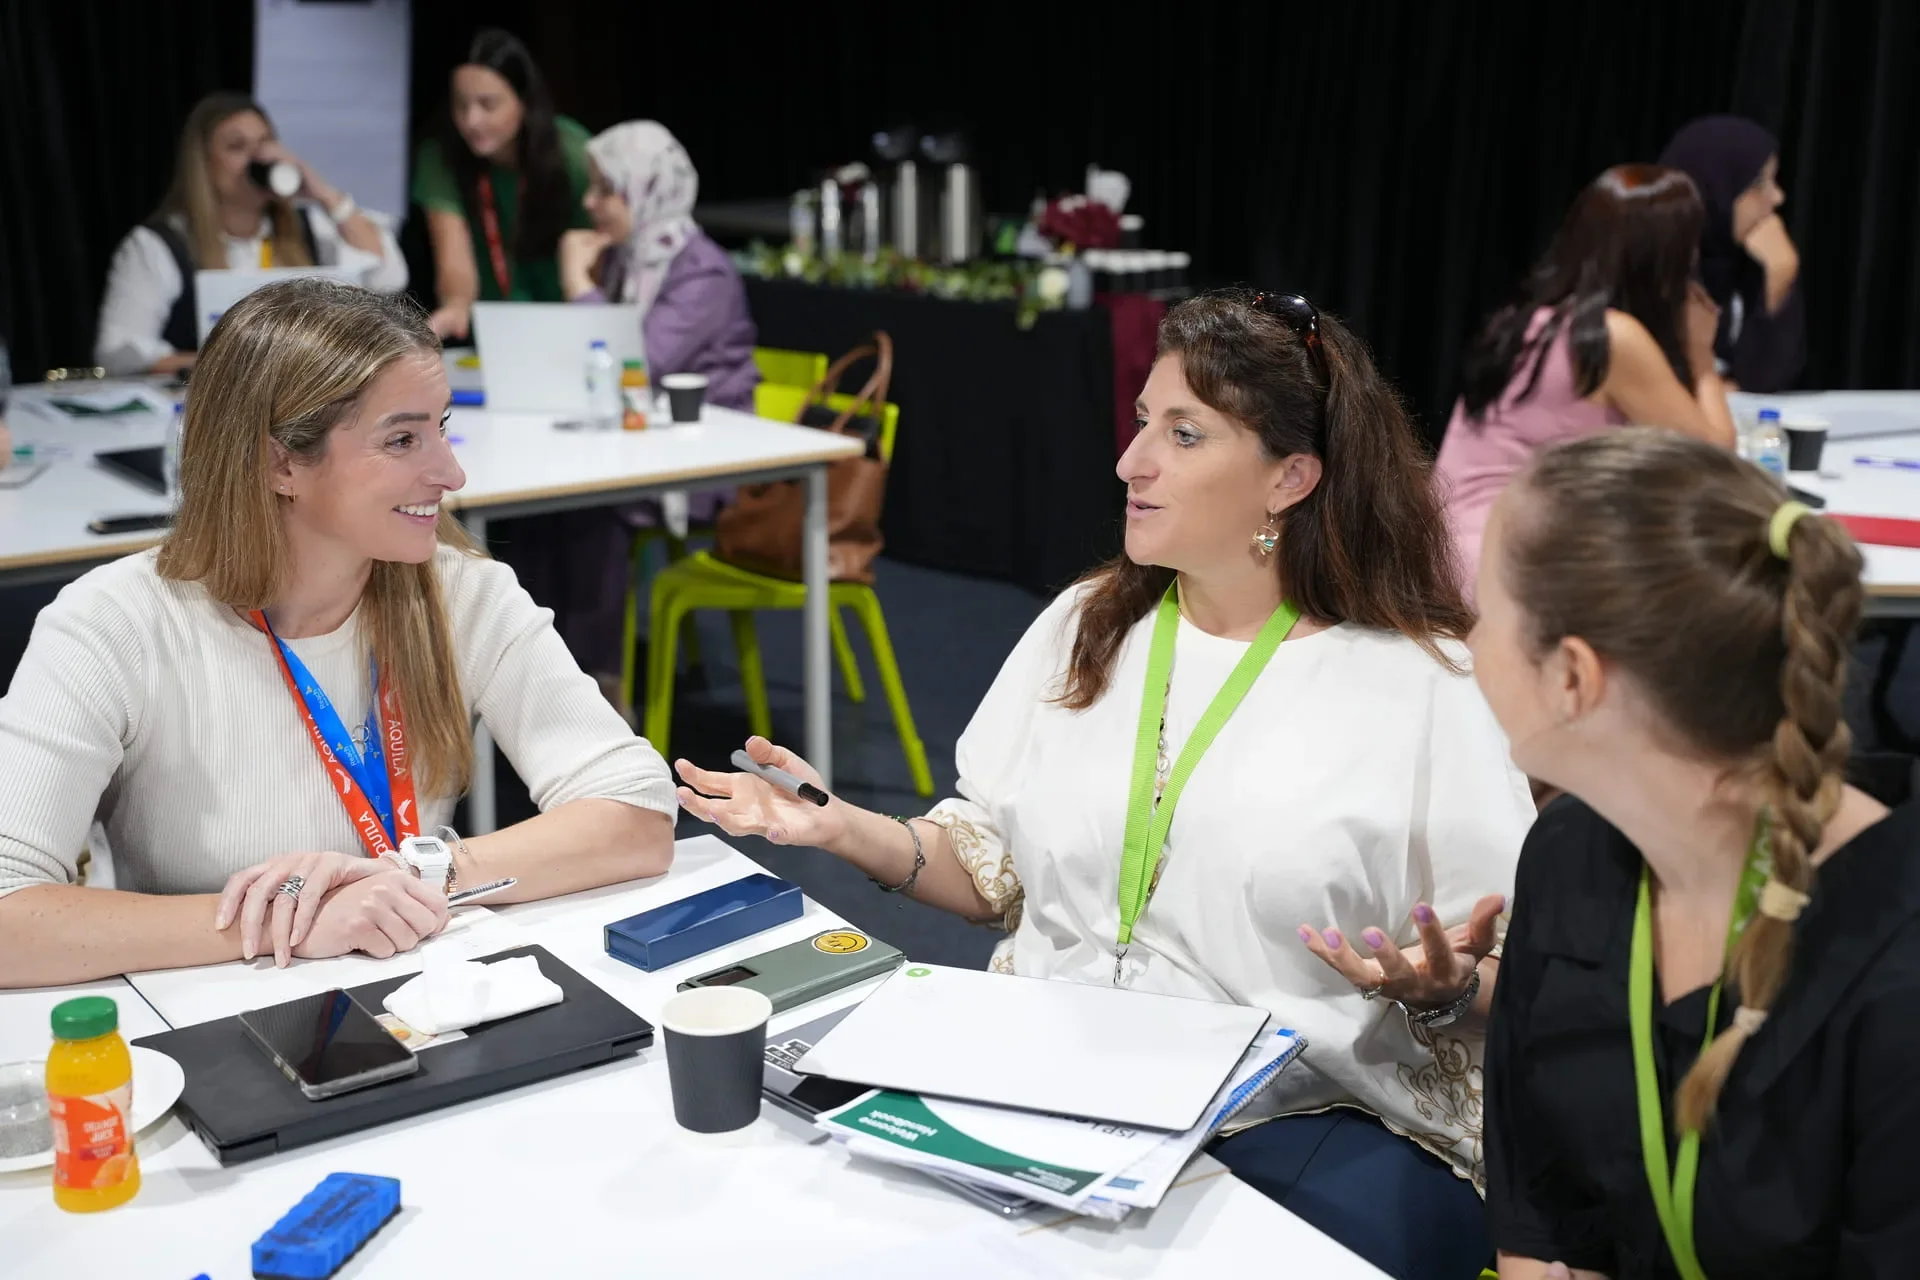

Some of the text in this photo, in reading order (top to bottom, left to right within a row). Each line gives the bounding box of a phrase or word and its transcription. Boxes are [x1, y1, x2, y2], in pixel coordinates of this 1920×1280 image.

[388, 719, 406, 777] AQUILA
[359, 810, 388, 856] QUILA
[858, 1116, 919, 1142] Welcome
[869, 1109, 938, 1137] Handbook
